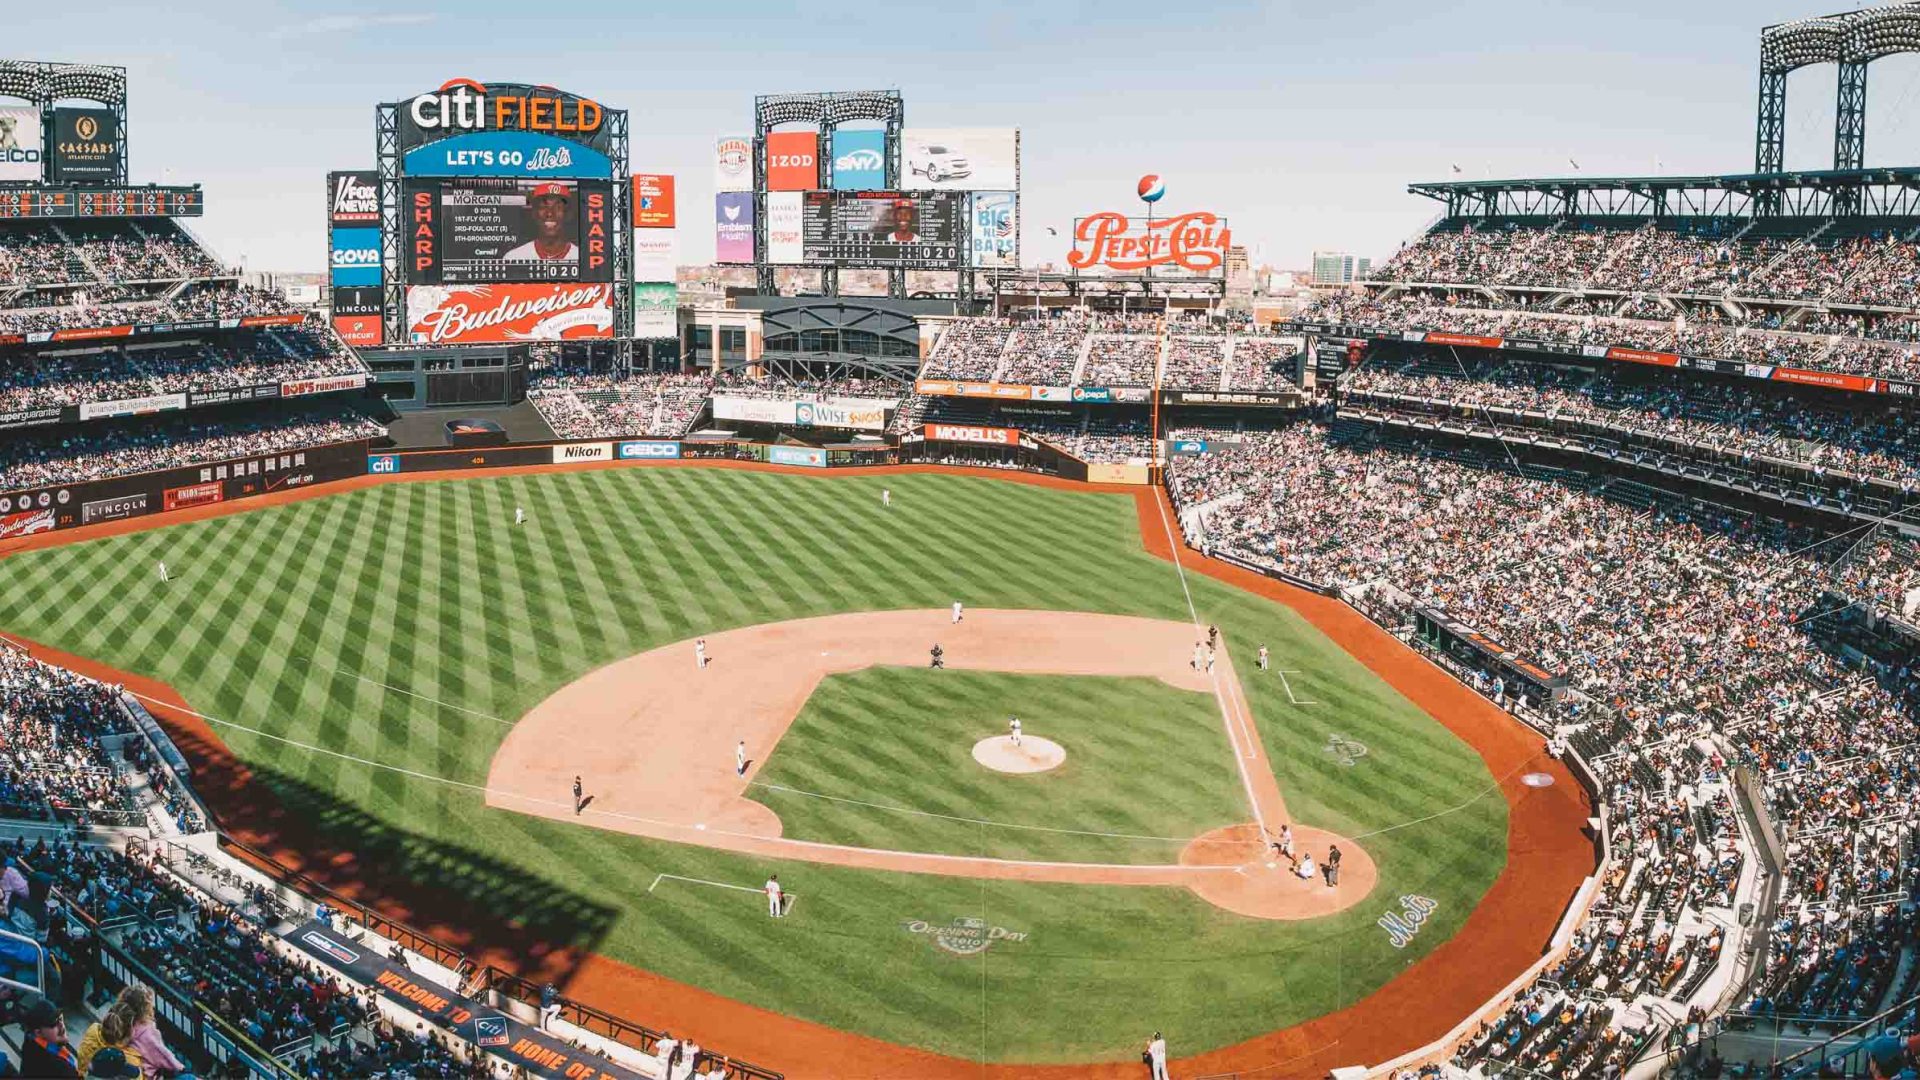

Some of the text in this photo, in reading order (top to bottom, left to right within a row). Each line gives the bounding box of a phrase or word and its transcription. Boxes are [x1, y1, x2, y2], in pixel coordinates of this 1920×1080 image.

[411, 86, 602, 131] citi FIELD
[58, 143, 114, 154] CAESARS
[447, 146, 573, 171] LET'S GO Mets
[771, 155, 813, 167] IZOD
[835, 154, 878, 170] SNY
[348, 186, 377, 200] FOX
[453, 195, 501, 205] MORGAN
[340, 200, 379, 213] NEWS
[978, 209, 1010, 230] BIG
[415, 192, 433, 271] SHARP
[588, 194, 604, 270] SHARP
[718, 223, 752, 232] Emblem
[333, 249, 380, 265] GOYA
[923, 248, 931, 258] 0
[936, 248, 943, 258] 2
[948, 248, 956, 258] 0
[550, 266, 578, 276] 0 2 0
[336, 305, 380, 313] LINCOLN
[421, 286, 601, 342] Budweiser
[341, 332, 375, 340] MERCURY
[283, 379, 354, 395] BOB'S FURNITURE
[1889, 385, 1913, 394] WSH 4
[232, 392, 240, 400] At
[240, 391, 252, 399] Bat
[1085, 391, 1108, 400] pepsi
[88, 398, 179, 414] Alliance Building Services
[935, 427, 1007, 443] MODELL'S
[564, 447, 602, 458] Nikon
[372, 458, 393, 472] citi
[90, 500, 147, 516] LINCOLN
[1377, 894, 1438, 948] Mets
[376, 969, 472, 1024] WELCOME TO
[478, 1020, 502, 1036] citi
[480, 1036, 508, 1045] FIELD
[510, 1038, 596, 1080] HOME OF
